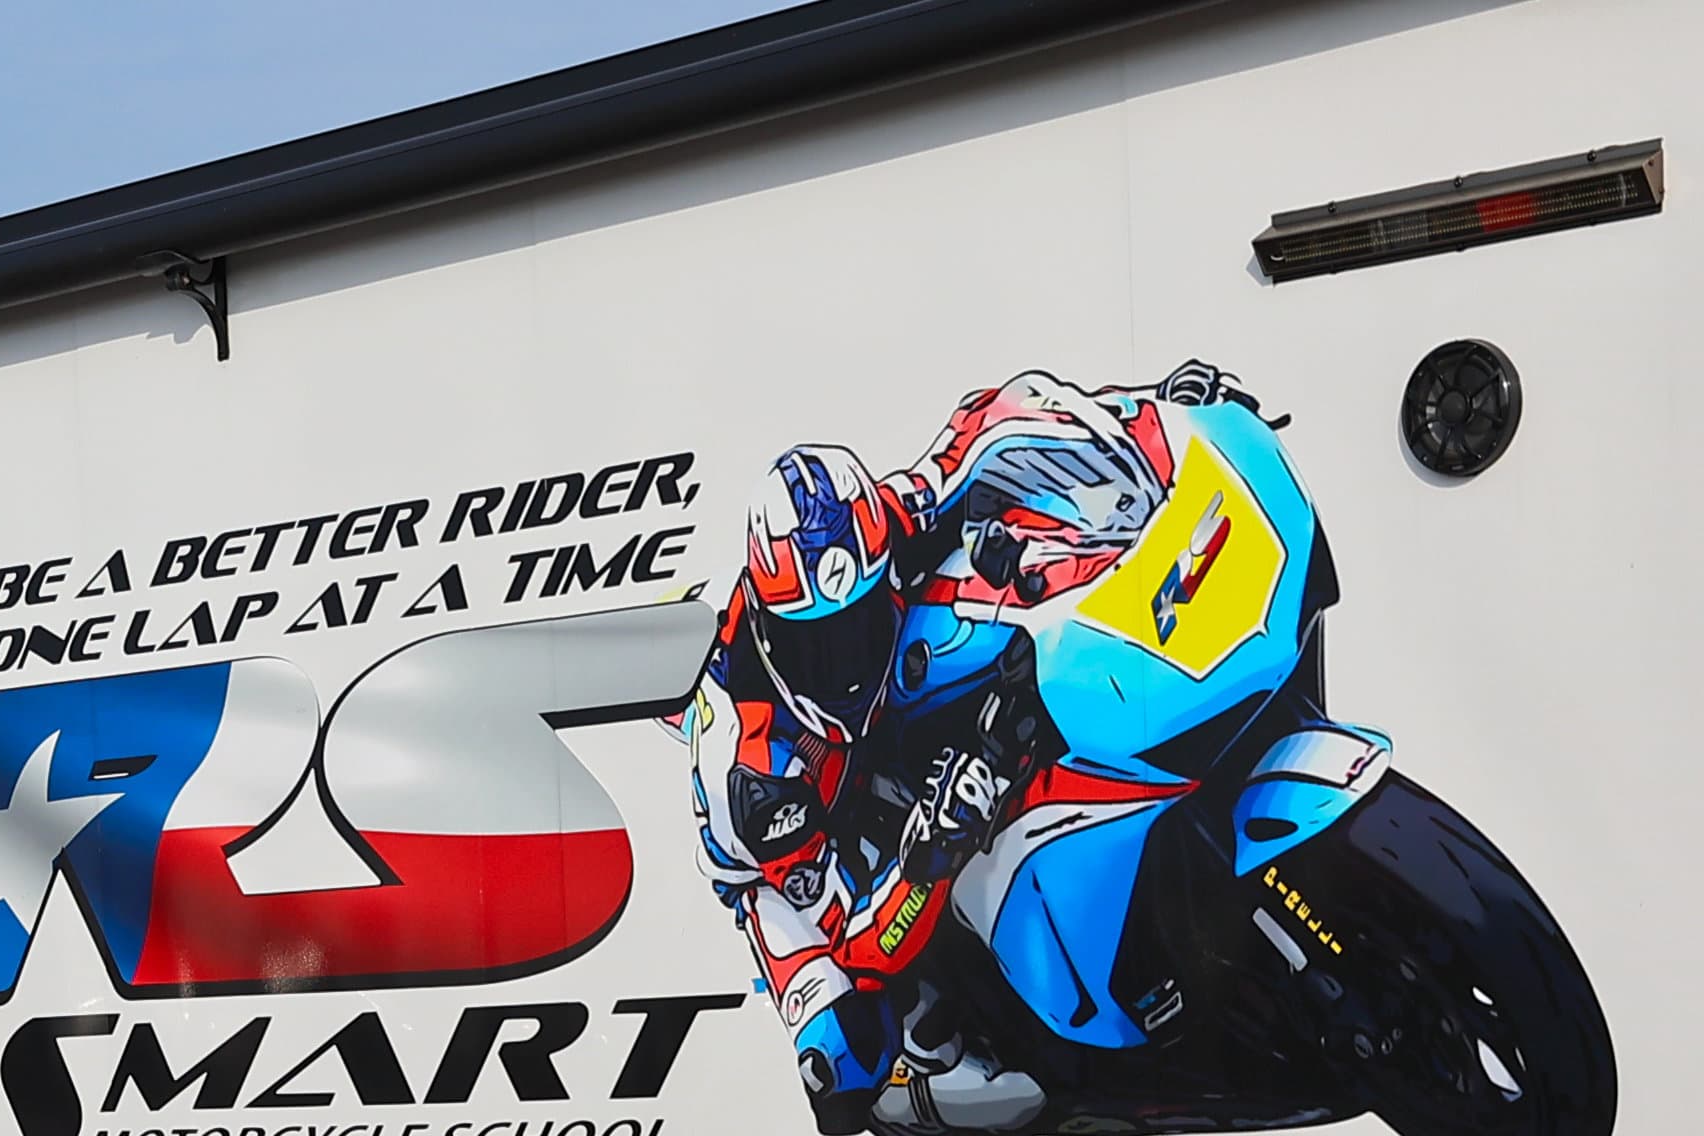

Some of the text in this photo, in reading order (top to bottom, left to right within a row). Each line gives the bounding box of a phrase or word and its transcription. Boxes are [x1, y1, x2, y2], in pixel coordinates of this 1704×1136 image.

[75, 549, 131, 598] A
[151, 499, 429, 587] BETTER
[440, 452, 700, 543] RIDER,
[123, 591, 279, 654] LAP
[284, 571, 400, 634] AT
[401, 564, 469, 618] A
[503, 524, 695, 604] TIME
[1263, 866, 1343, 955] PIRELLI
